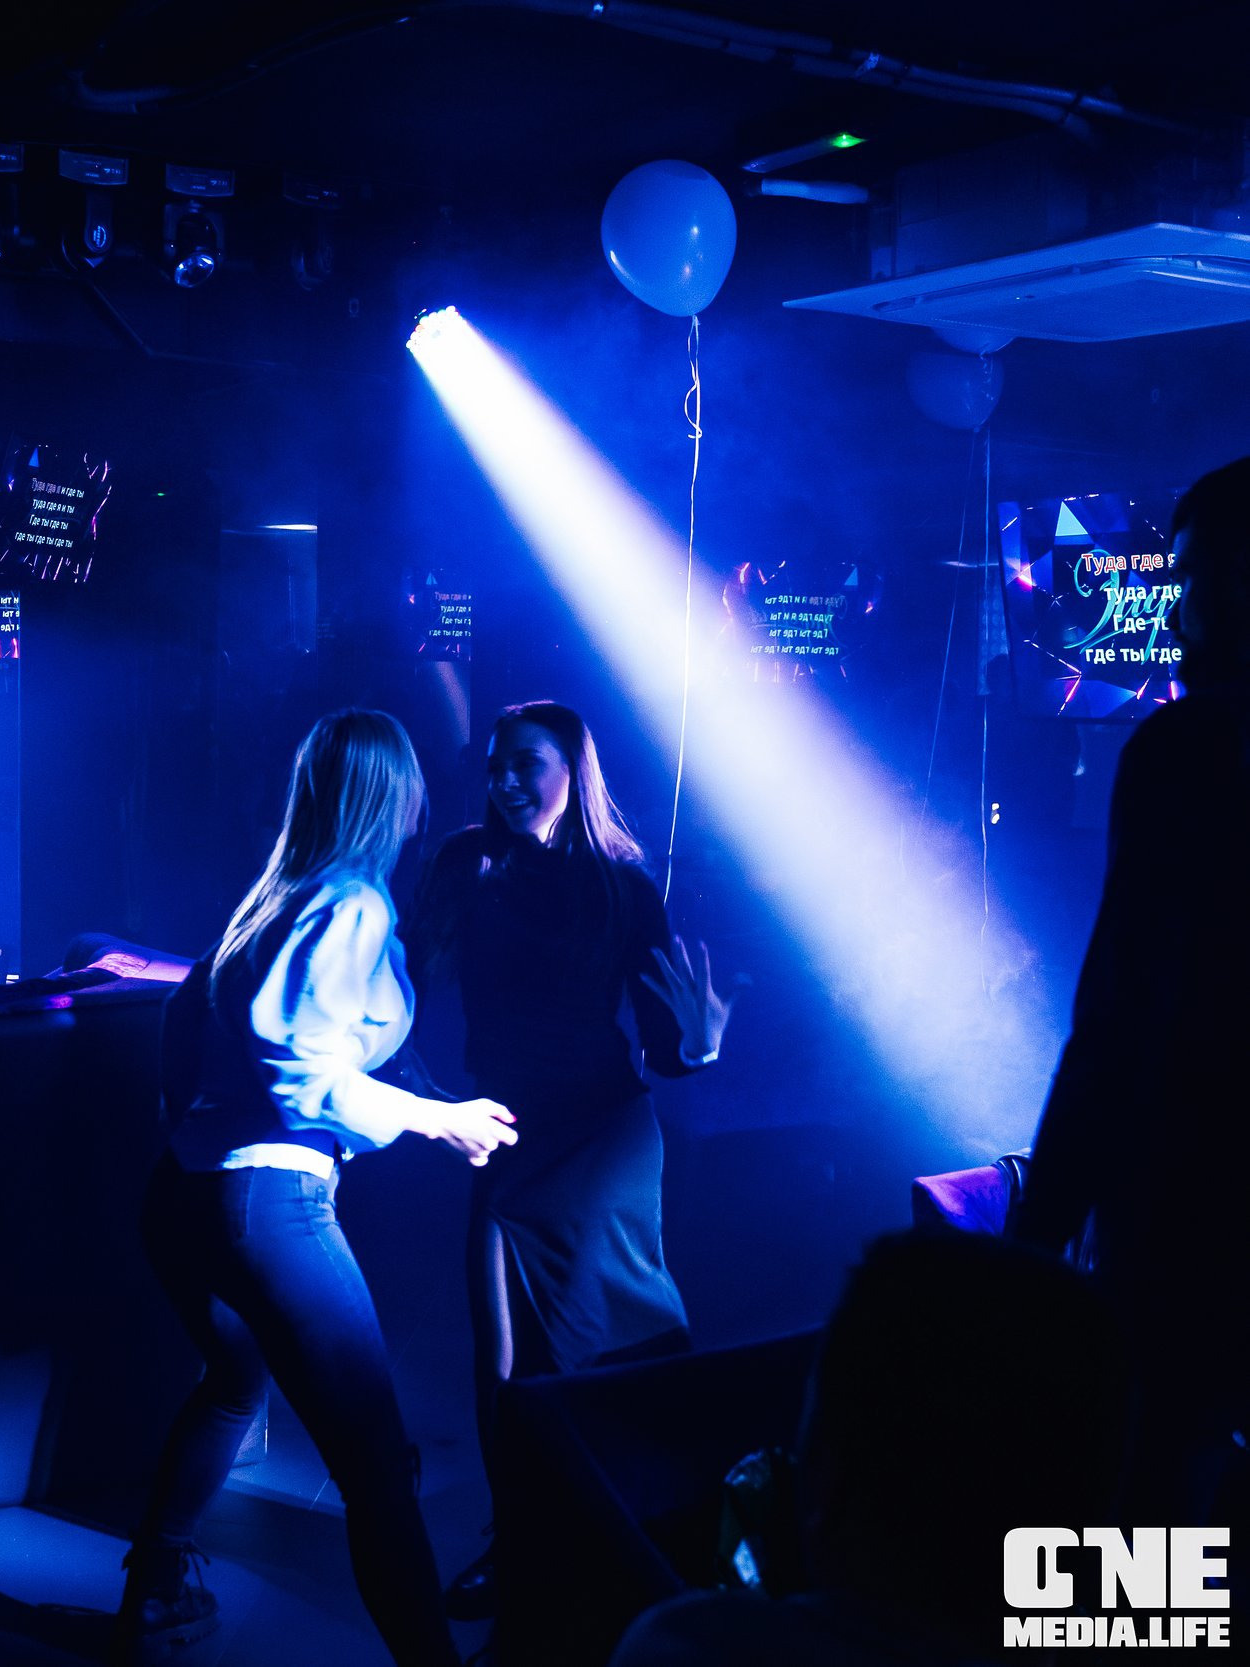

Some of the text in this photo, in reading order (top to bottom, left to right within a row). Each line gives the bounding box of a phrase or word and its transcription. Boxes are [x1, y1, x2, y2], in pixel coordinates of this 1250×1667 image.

[46, 502, 57, 511] где
[29, 514, 69, 530] Где ты где ты
[15, 532, 74, 548] где ты где ты где ты
[1081, 553, 1127, 576] Туда
[1131, 554, 1163, 571] где
[1104, 585, 1182, 605] туда где
[442, 616, 453, 625] Где
[1113, 614, 1146, 633] Где
[1086, 648, 1182, 664] где ты где
